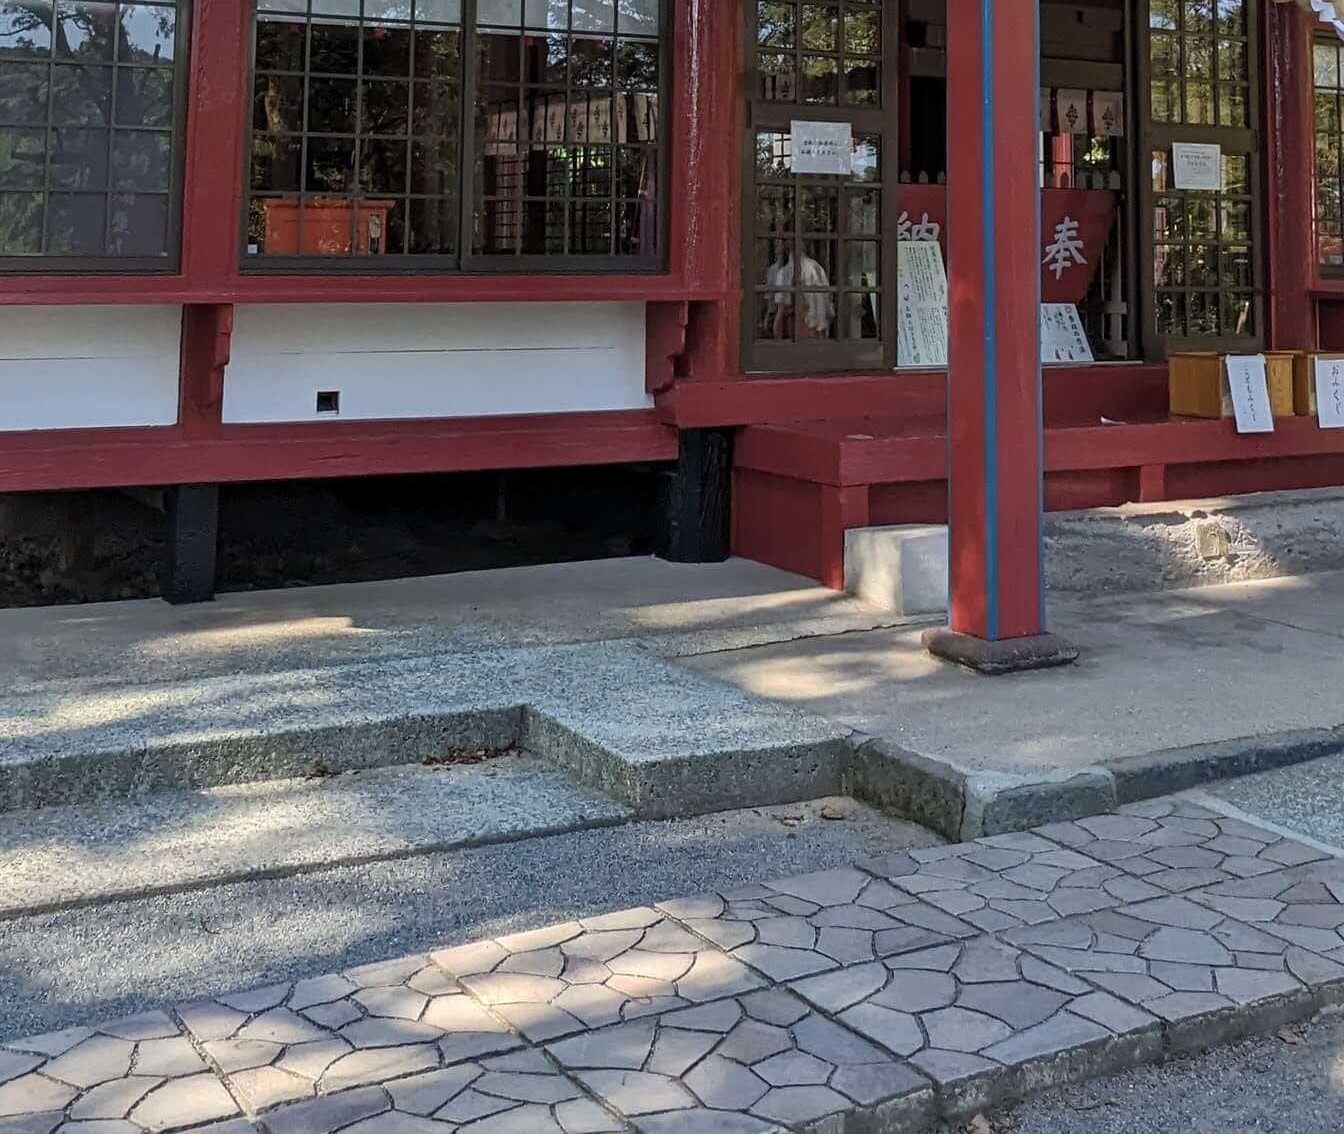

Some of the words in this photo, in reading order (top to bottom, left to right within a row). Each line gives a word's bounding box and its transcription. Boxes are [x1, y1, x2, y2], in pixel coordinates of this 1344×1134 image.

[1042, 216, 1089, 280] 奉
[1331, 364, 1343, 417] おみくじ
